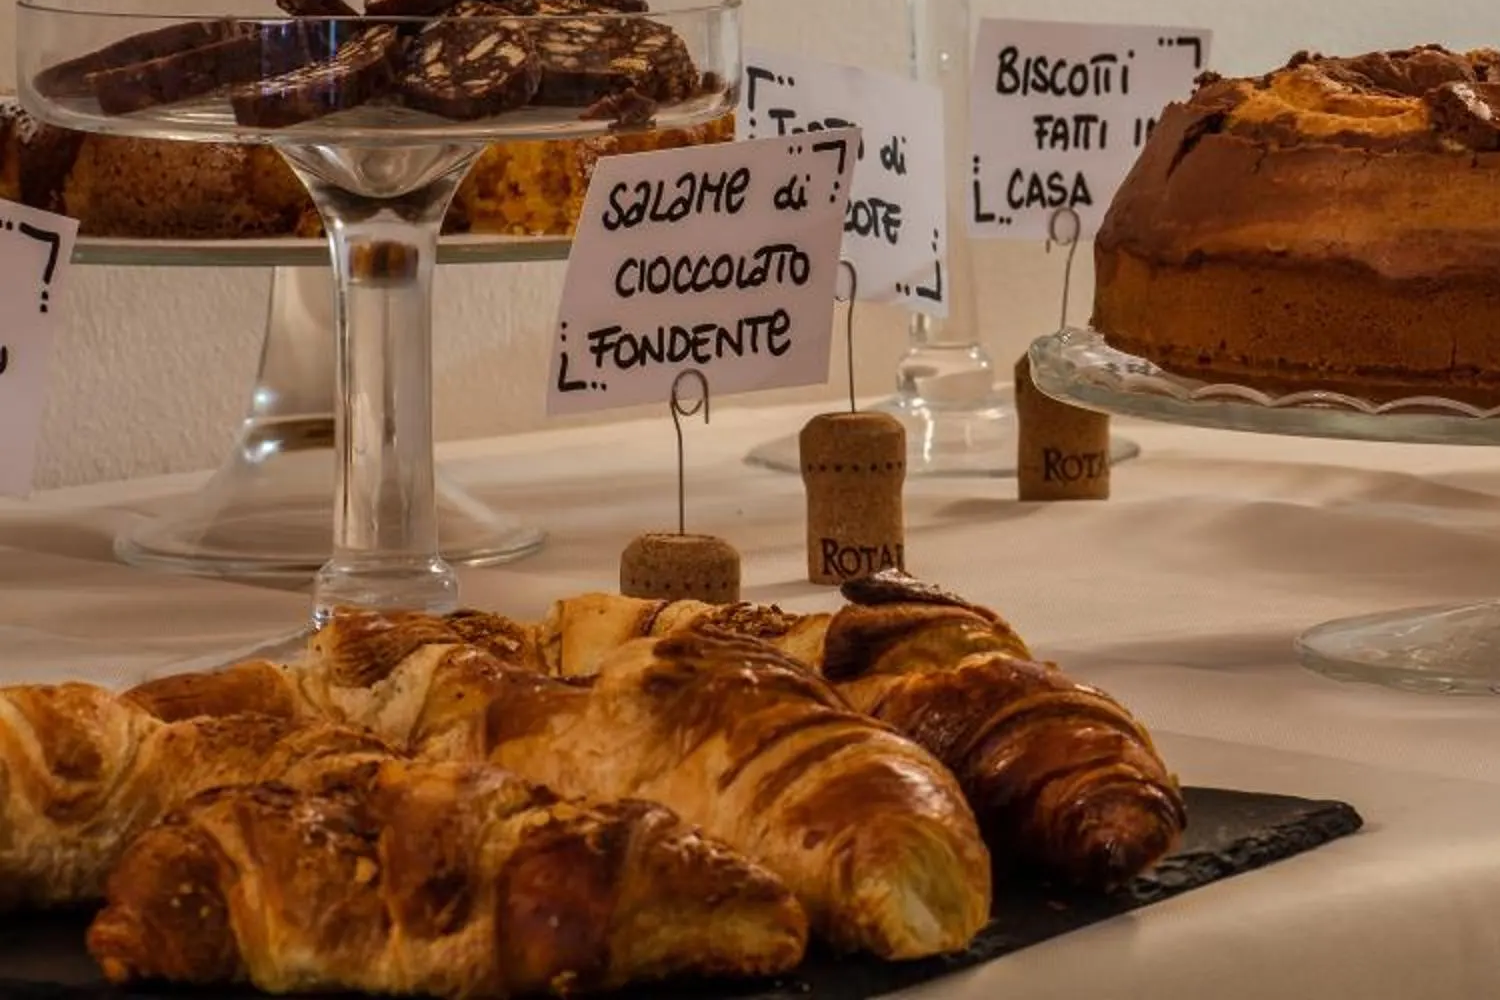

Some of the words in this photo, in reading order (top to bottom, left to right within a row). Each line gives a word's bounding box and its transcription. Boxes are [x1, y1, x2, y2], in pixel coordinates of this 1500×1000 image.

[1034, 114, 1107, 151] FATTI
[880, 135, 907, 175] di
[773, 173, 811, 210] di
[1007, 168, 1093, 209] CASA
